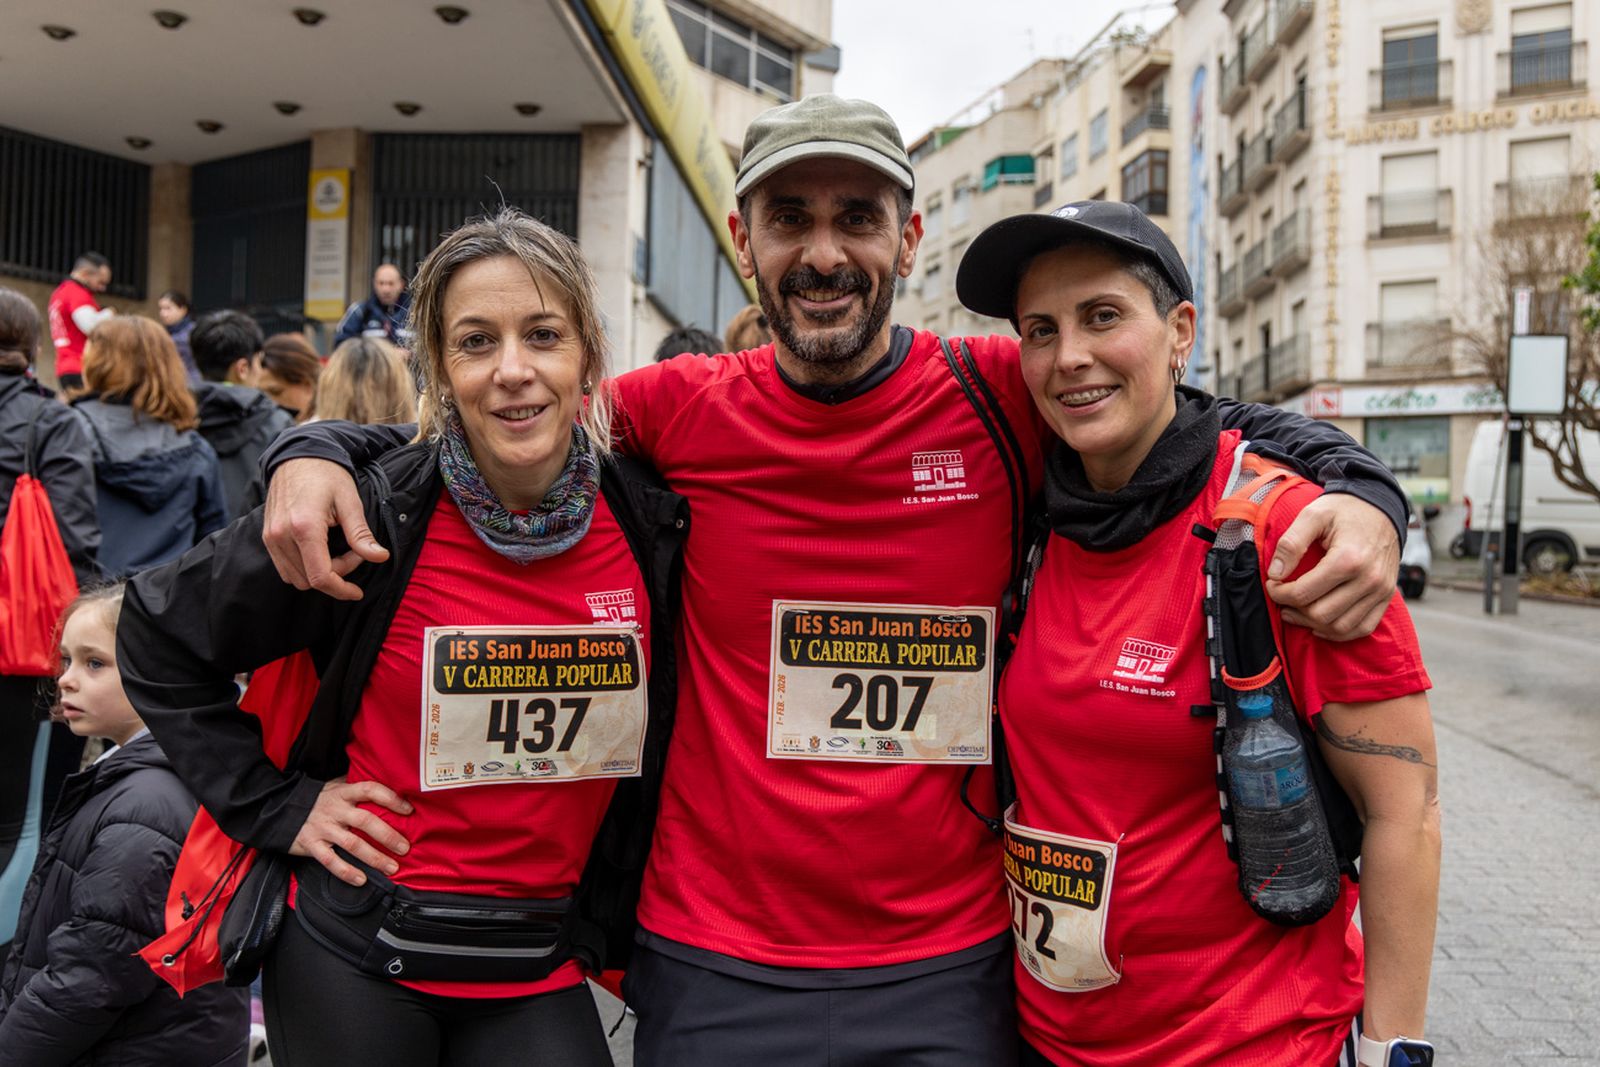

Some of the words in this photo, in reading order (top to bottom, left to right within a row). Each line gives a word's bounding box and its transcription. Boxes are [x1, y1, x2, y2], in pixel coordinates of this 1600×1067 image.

[1344, 120, 1419, 146] ILUSTRE
[1429, 105, 1518, 137] COLEGIO
[794, 615, 824, 634] IES
[829, 616, 864, 636] San
[868, 617, 914, 637] Juan
[920, 618, 973, 639] Bosco
[449, 640, 479, 660] IES
[486, 639, 522, 660] San
[528, 639, 573, 660] Juan
[578, 638, 626, 658] Bosco
[789, 639, 803, 661] V
[807, 639, 891, 664] CARRERA
[897, 643, 978, 667] POPULAR
[443, 666, 458, 689] V
[463, 664, 550, 689] CARRERA
[556, 663, 634, 687] POPULAR
[1116, 682, 1130, 692] San
[1130, 686, 1149, 695] Juan
[1150, 688, 1176, 697] Bosco
[830, 672, 935, 732] 207
[486, 697, 592, 755] 437
[1041, 844, 1094, 872] Bosco
[1024, 866, 1096, 904] POPULAR
